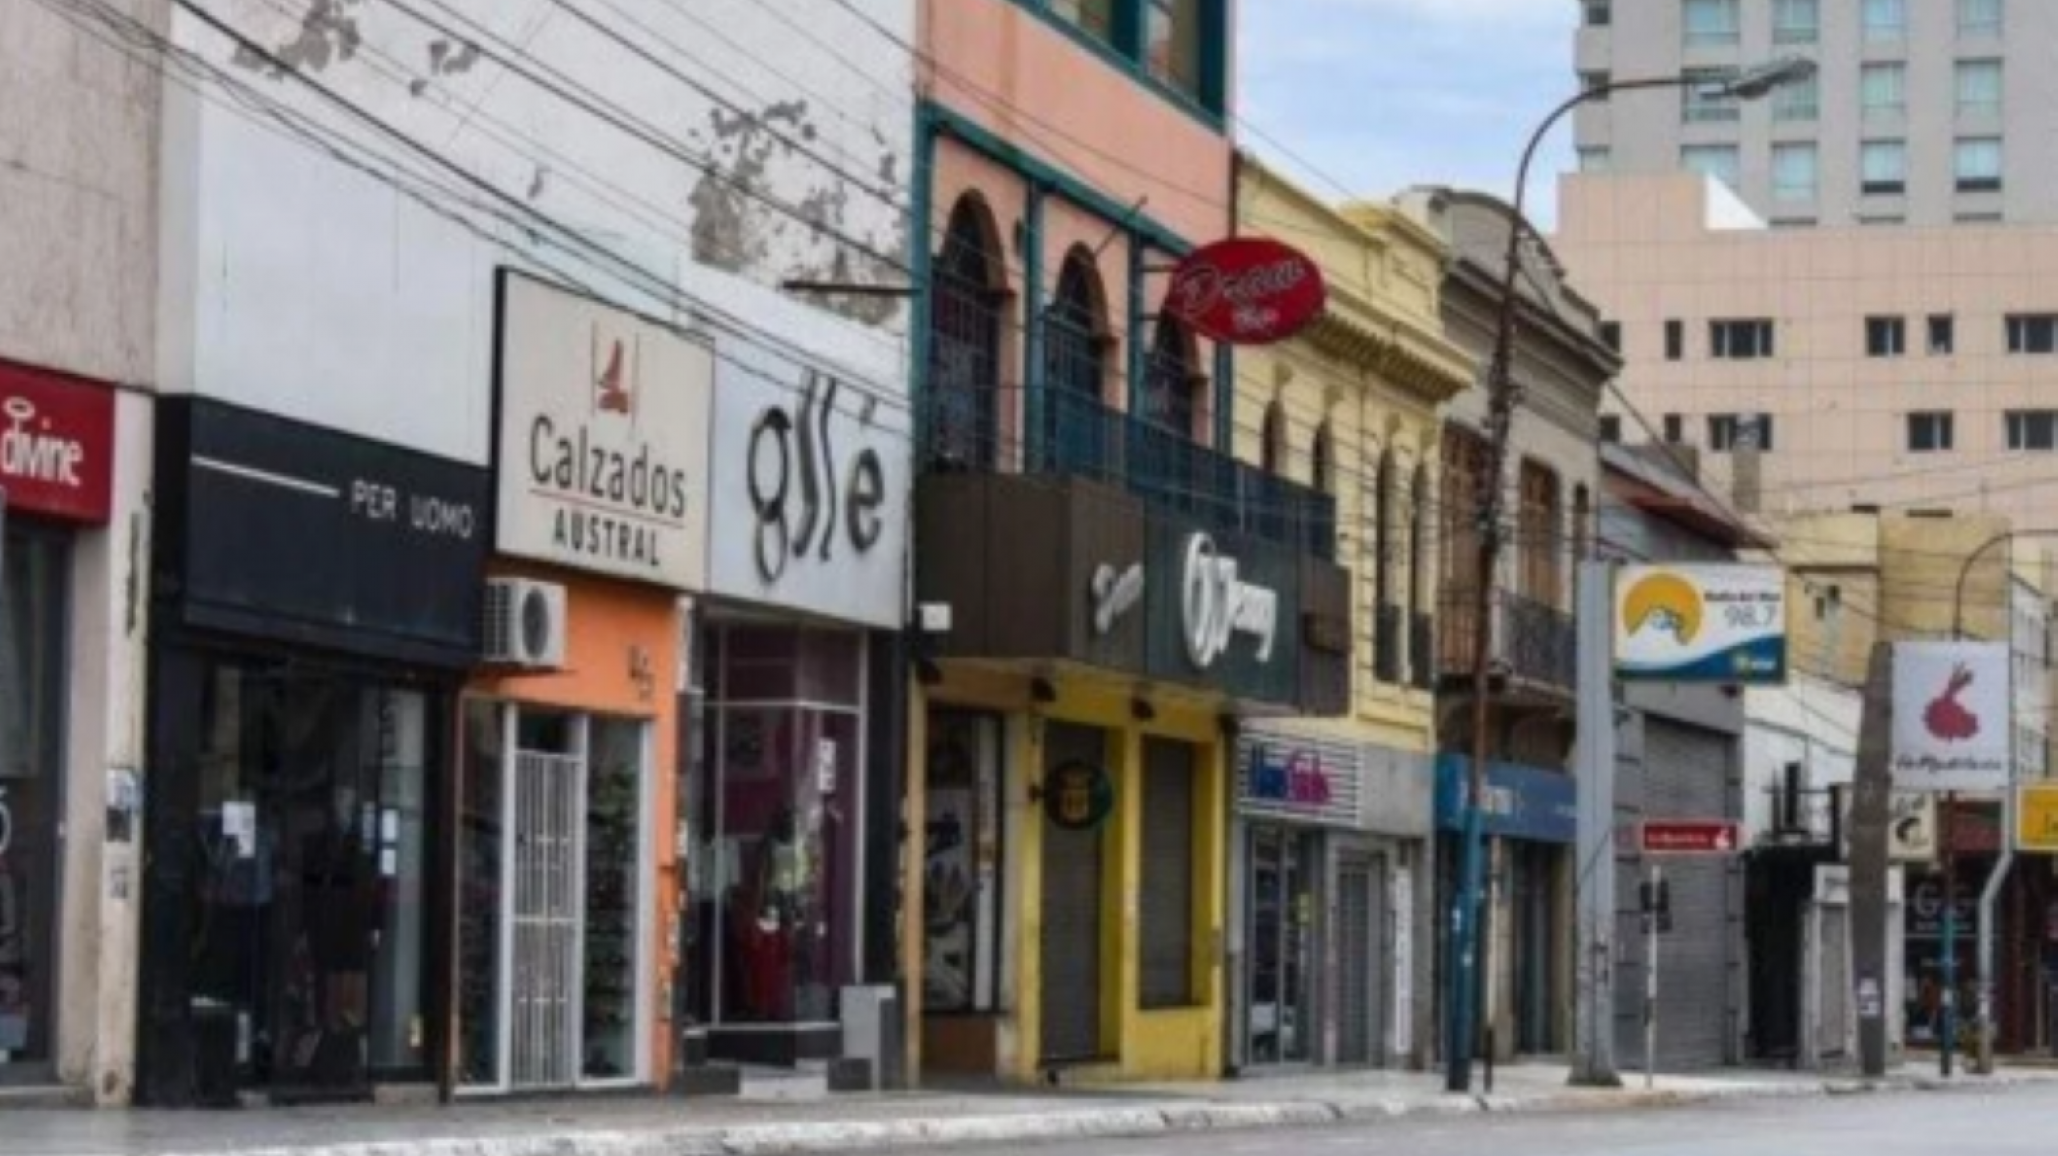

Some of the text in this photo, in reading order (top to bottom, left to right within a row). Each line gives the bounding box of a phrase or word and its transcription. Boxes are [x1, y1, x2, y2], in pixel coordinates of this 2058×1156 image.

[530, 412, 685, 518] Calzados
[410, 494, 475, 539] UOMO
[552, 507, 660, 567] AUSTRAL
[1724, 604, 1777, 628] 98.7
